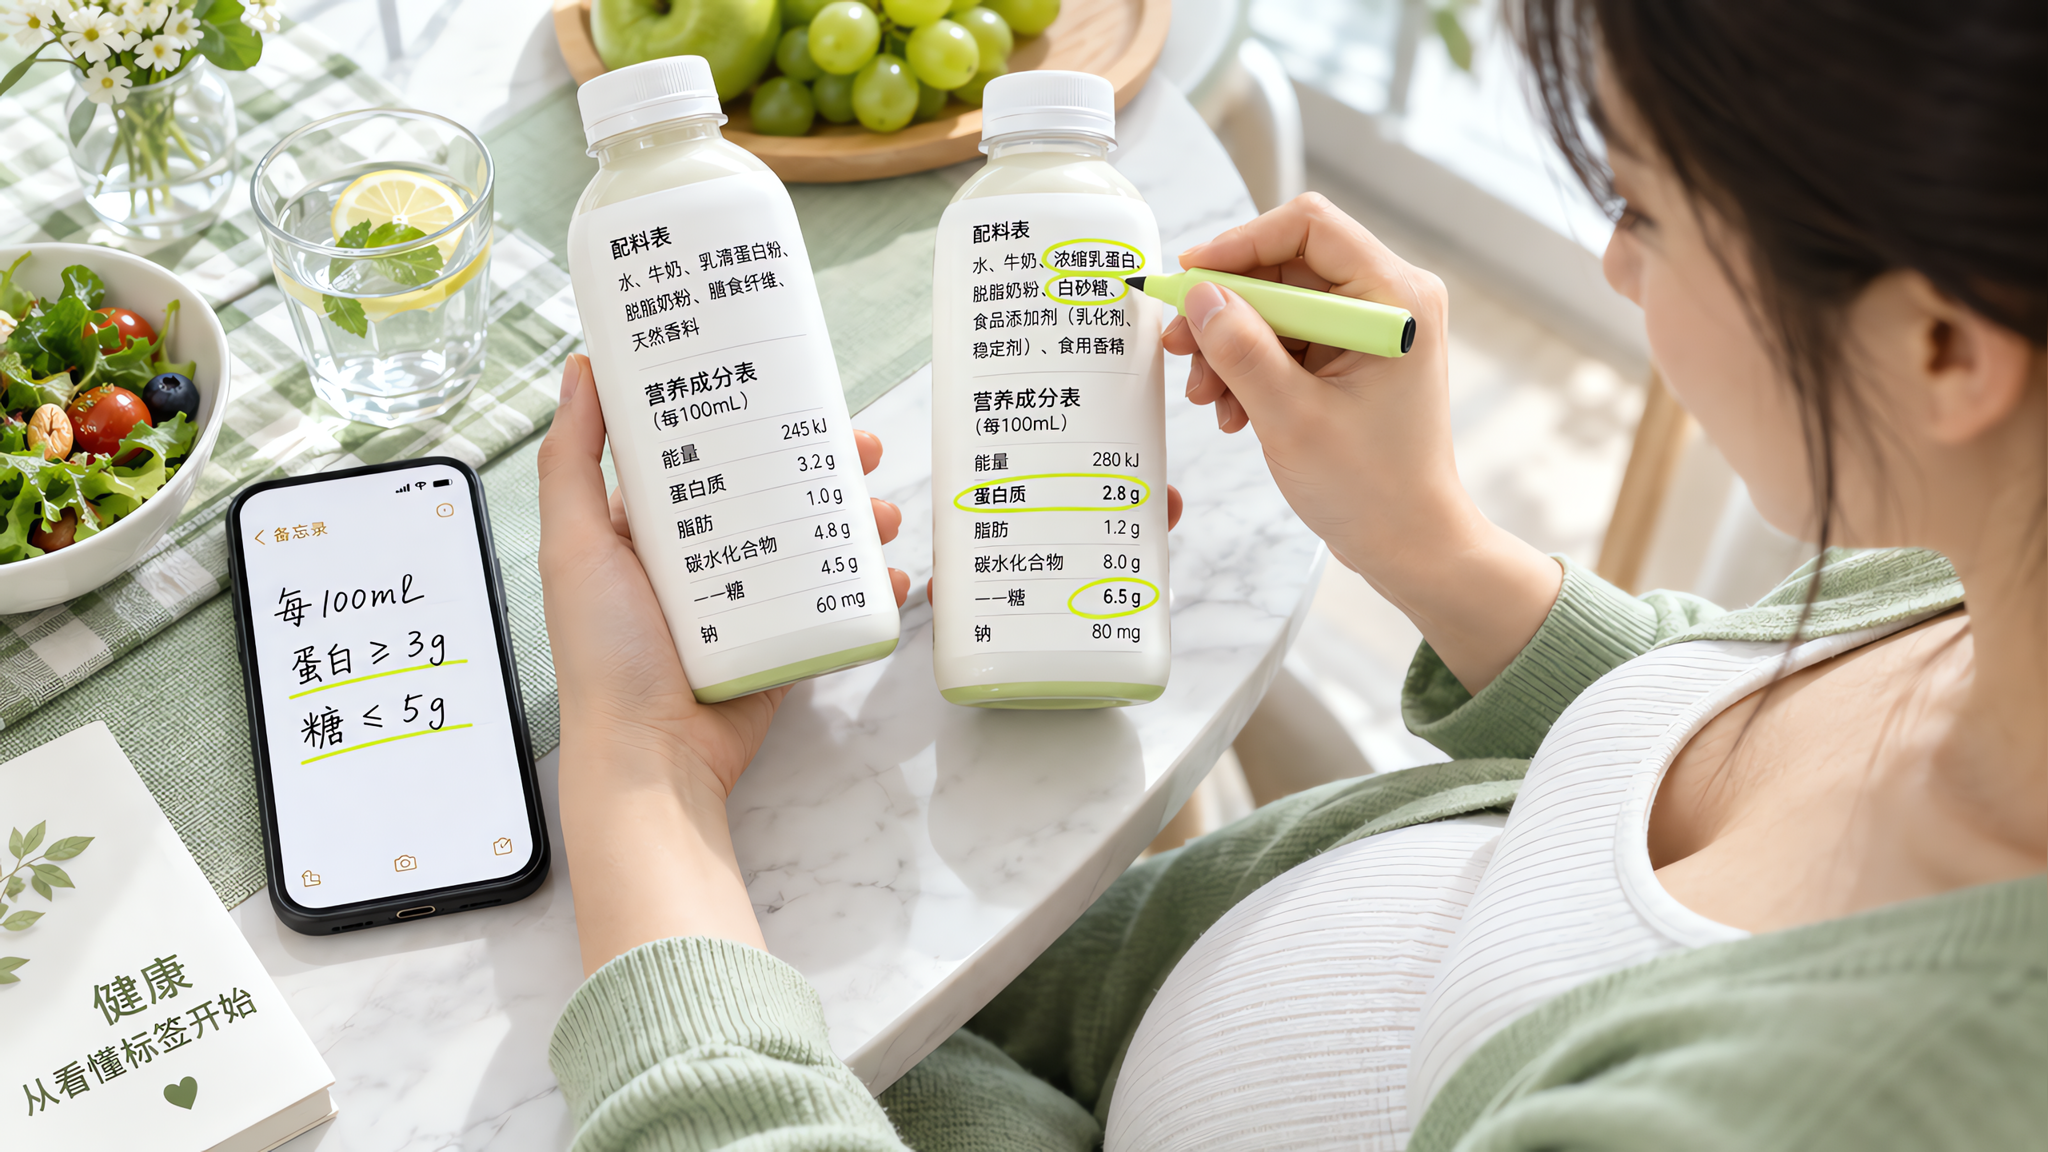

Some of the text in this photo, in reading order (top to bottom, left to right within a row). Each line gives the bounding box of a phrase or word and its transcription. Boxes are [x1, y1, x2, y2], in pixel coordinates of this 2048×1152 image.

[609, 226, 673, 261] 配料表
[972, 219, 1031, 245] 配料表
[631, 316, 700, 352] 天然香料
[972, 306, 1132, 332] 食品添加剂（乳化剂、
[644, 361, 758, 407] 营养成分表
[973, 386, 1081, 413] 营养成分表
[653, 391, 748, 432] (每100mL)
[975, 413, 1067, 437] (每100mL)
[661, 417, 828, 470] 能量 245 kJ
[668, 453, 836, 505] 蛋白质 3.2 g
[974, 451, 1140, 473] 能量 280 kJ
[973, 484, 1140, 506] 蛋白质 2.8 g
[676, 487, 843, 540] 脂肪 1.0 g
[973, 519, 1140, 540] 脂肪 1.2 g
[273, 521, 328, 543] 备忘录
[682, 521, 851, 574] 碳水化合物 4.8 g
[821, 556, 845, 575] 4.5
[847, 557, 859, 574] g
[974, 552, 1141, 574] 碳水化合物 8.0 g
[1103, 588, 1128, 605] 6.5
[1131, 592, 1141, 609] g
[700, 591, 866, 644] 钠 60 mg
[974, 623, 1141, 644] 钠 80 mg
[291, 630, 445, 686] 蛋白 ≥ 3g
[300, 693, 445, 750] 糖 ≤ 5g
[93, 953, 194, 1027] 健康
[22, 986, 258, 1117] 从看懂标签开始
